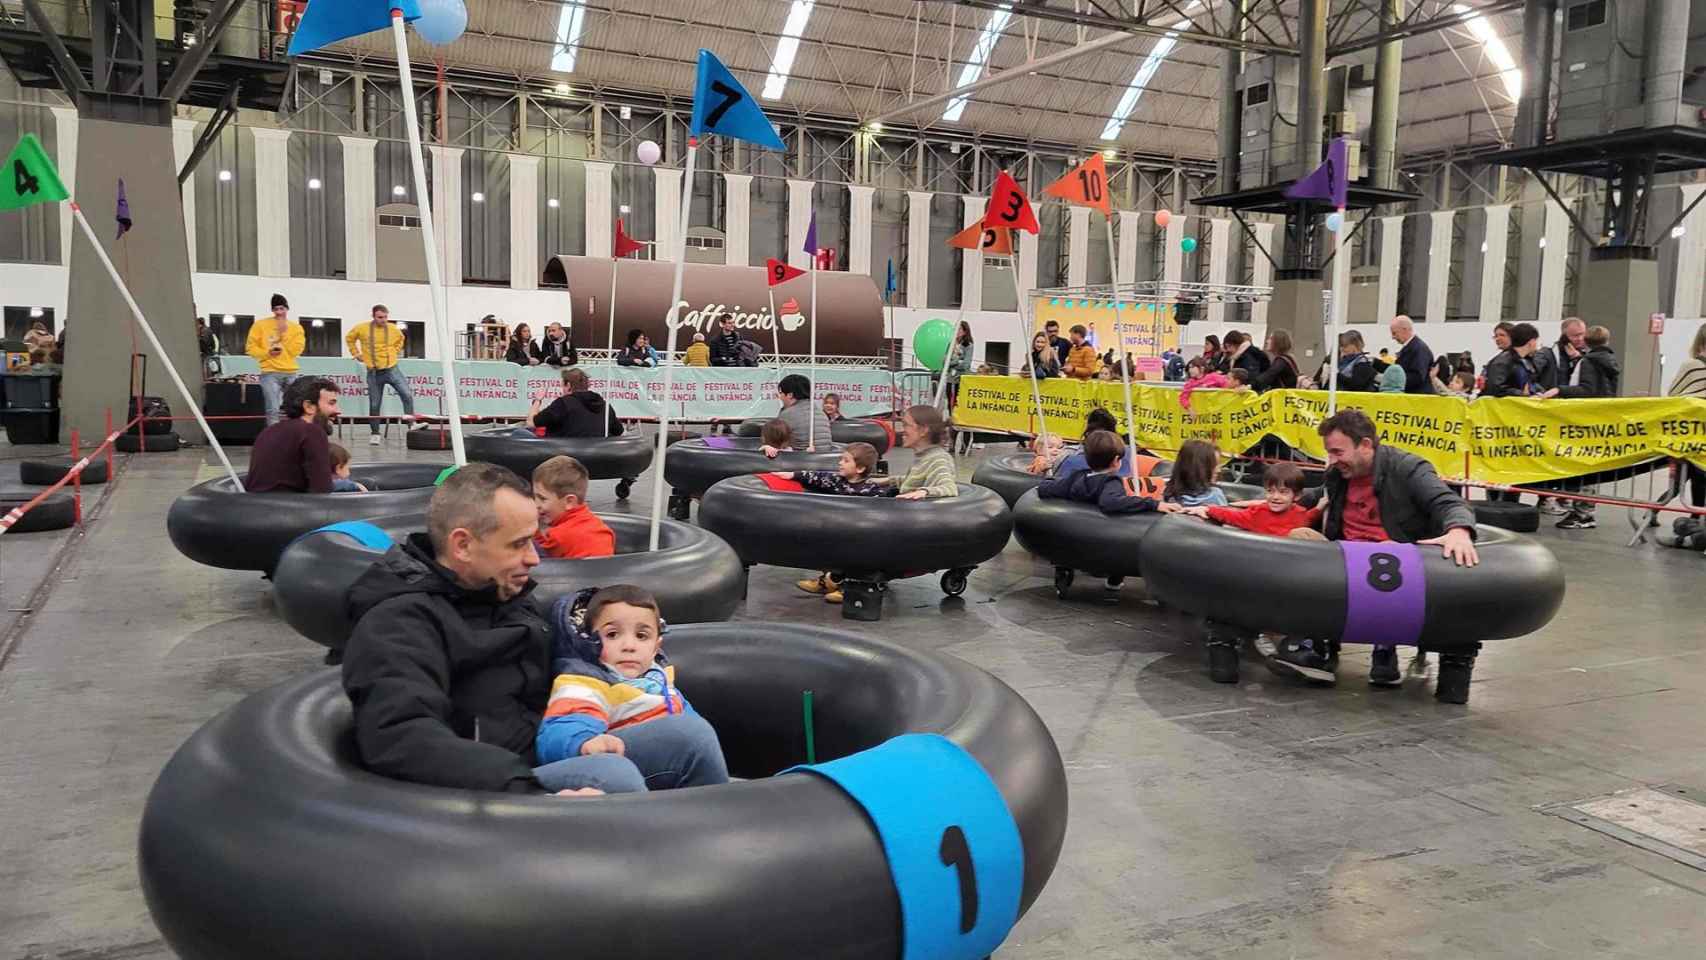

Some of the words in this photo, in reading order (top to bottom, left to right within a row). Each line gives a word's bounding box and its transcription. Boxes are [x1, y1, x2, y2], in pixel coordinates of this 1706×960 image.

[705, 80, 742, 128] 7
[14, 159, 39, 196] 4
[1078, 169, 1102, 202] 10
[1001, 192, 1023, 222] 3
[774, 264, 785, 280] 9
[665, 300, 775, 333] Cafficcio
[1113, 323, 1149, 333] FSTIVAL
[460, 377, 502, 388] FESTIVAL
[506, 379, 518, 388] DE
[527, 379, 562, 388] FESTIVA
[628, 381, 640, 390] DE
[687, 383, 697, 391] DE
[704, 382, 740, 391] FESTIVAL
[743, 383, 753, 391] DE
[815, 383, 849, 391] FESTIVAL
[852, 383, 863, 391] DE
[460, 390, 471, 398] LA
[967, 388, 1006, 401] FESTIVAL
[1008, 392, 1020, 402] DE
[966, 399, 977, 410] LA
[1375, 410, 1440, 430] FESTIVAL
[1444, 420, 1463, 434] DE
[1528, 425, 1547, 438] DE
[1560, 423, 1622, 439] FESTIVAL
[1626, 421, 1648, 437] DE
[1380, 431, 1389, 441] A
[1393, 432, 1456, 453] INFÀNCIA
[1554, 445, 1573, 457] LA
[1366, 552, 1403, 592] 8
[939, 825, 980, 935] 1
